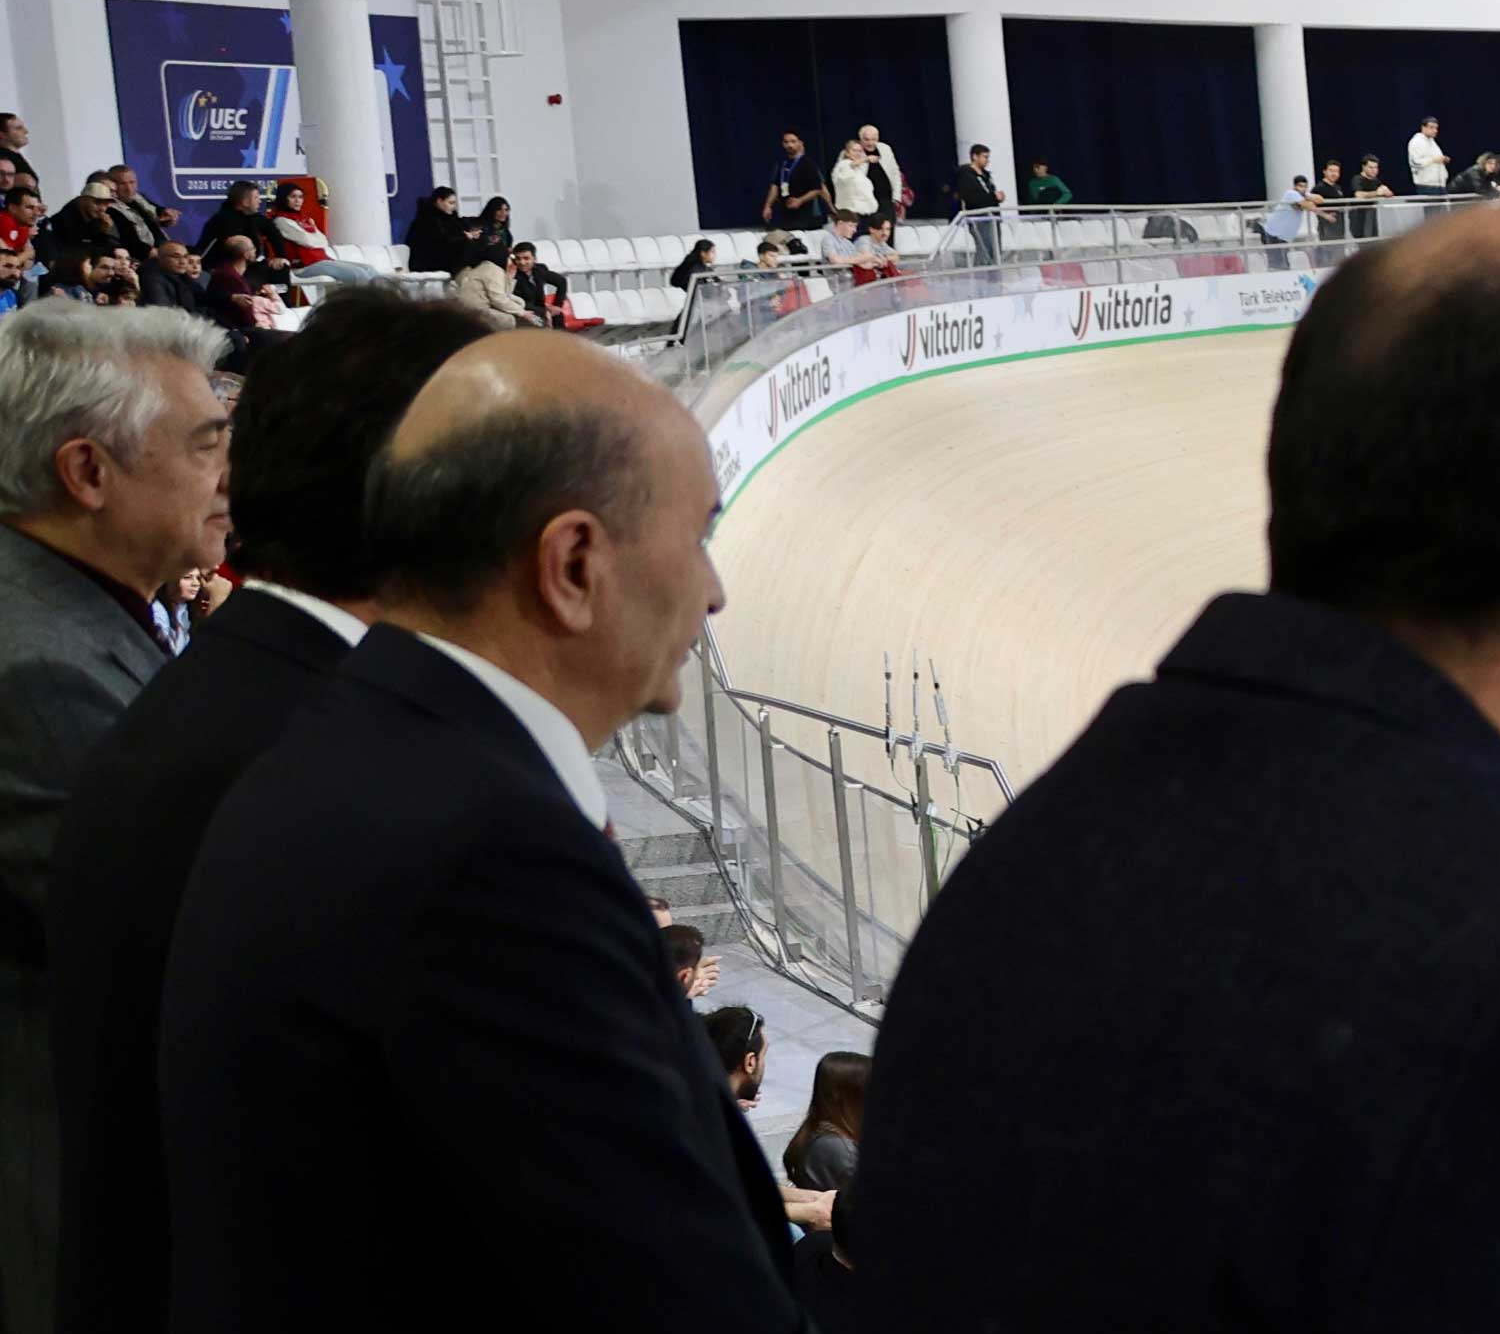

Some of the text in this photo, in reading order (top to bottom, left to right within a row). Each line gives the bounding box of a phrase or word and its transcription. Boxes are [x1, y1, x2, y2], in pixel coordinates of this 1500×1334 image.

[210, 108, 248, 129] UEC
[919, 304, 984, 359] vittoria
[1095, 284, 1172, 331] vittoria
[779, 346, 831, 422] vittoria
